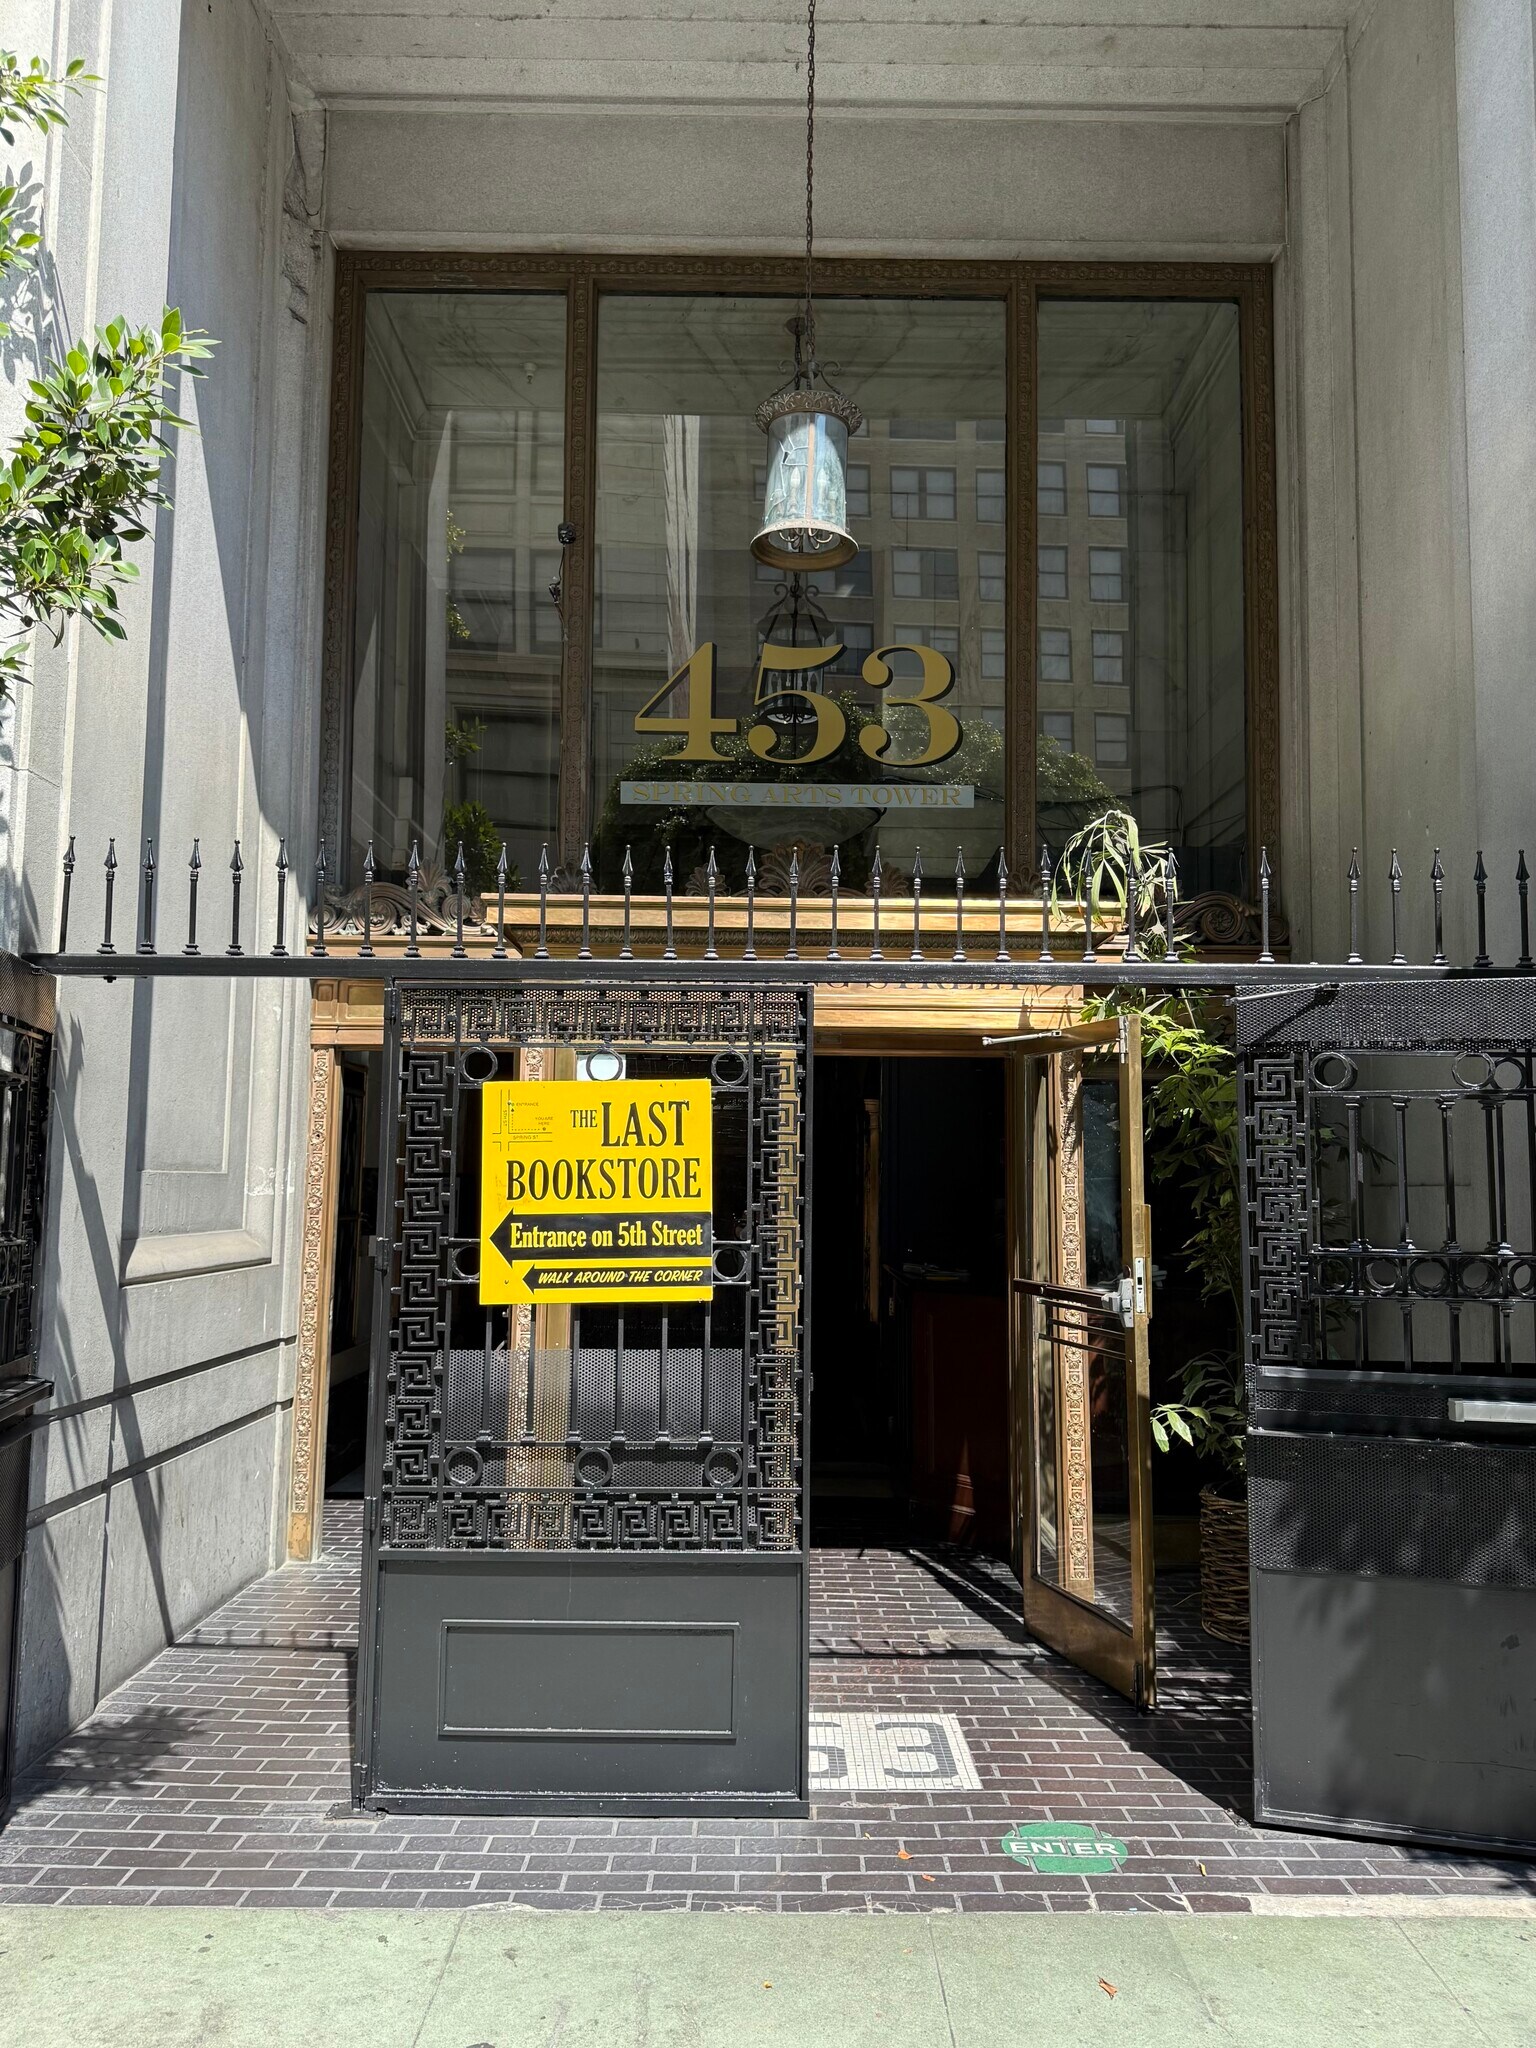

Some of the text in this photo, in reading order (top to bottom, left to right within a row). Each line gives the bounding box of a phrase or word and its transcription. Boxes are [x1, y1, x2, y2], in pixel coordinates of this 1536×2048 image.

[634, 642, 962, 766] 453
[632, 783, 963, 806] SPRING ARTS TOWER
[570, 1100, 690, 1146] THE LAST
[506, 1157, 701, 1200] BOOKSTORE
[510, 1220, 703, 1249] Entrance on 5th Street
[538, 1269, 703, 1284] WALK AROUND THE CORNER
[1009, 1841, 1121, 1855] ENTER
